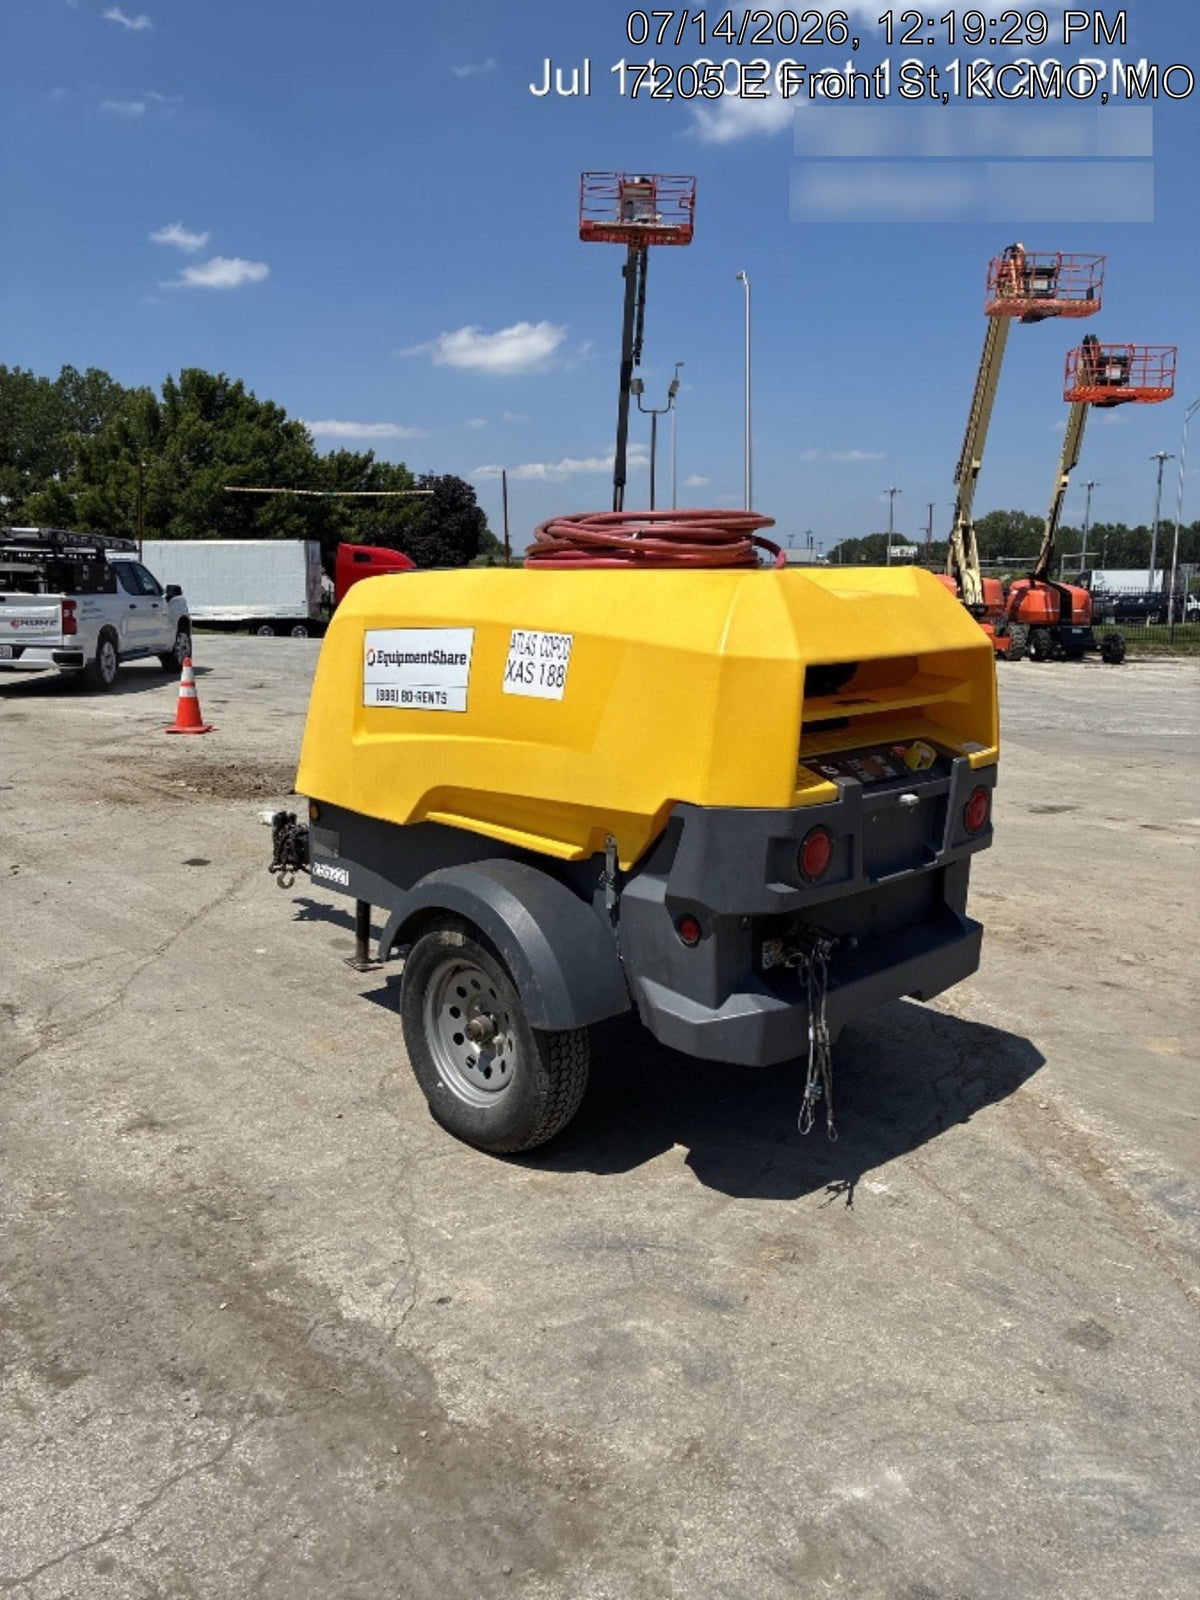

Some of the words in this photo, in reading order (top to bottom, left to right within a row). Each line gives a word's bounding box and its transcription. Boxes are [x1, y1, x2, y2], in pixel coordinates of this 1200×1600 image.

[510, 632, 538, 657] ATLAS
[376, 649, 467, 667] EquipmentShare
[504, 659, 535, 684] XAS
[540, 663, 566, 688] 188
